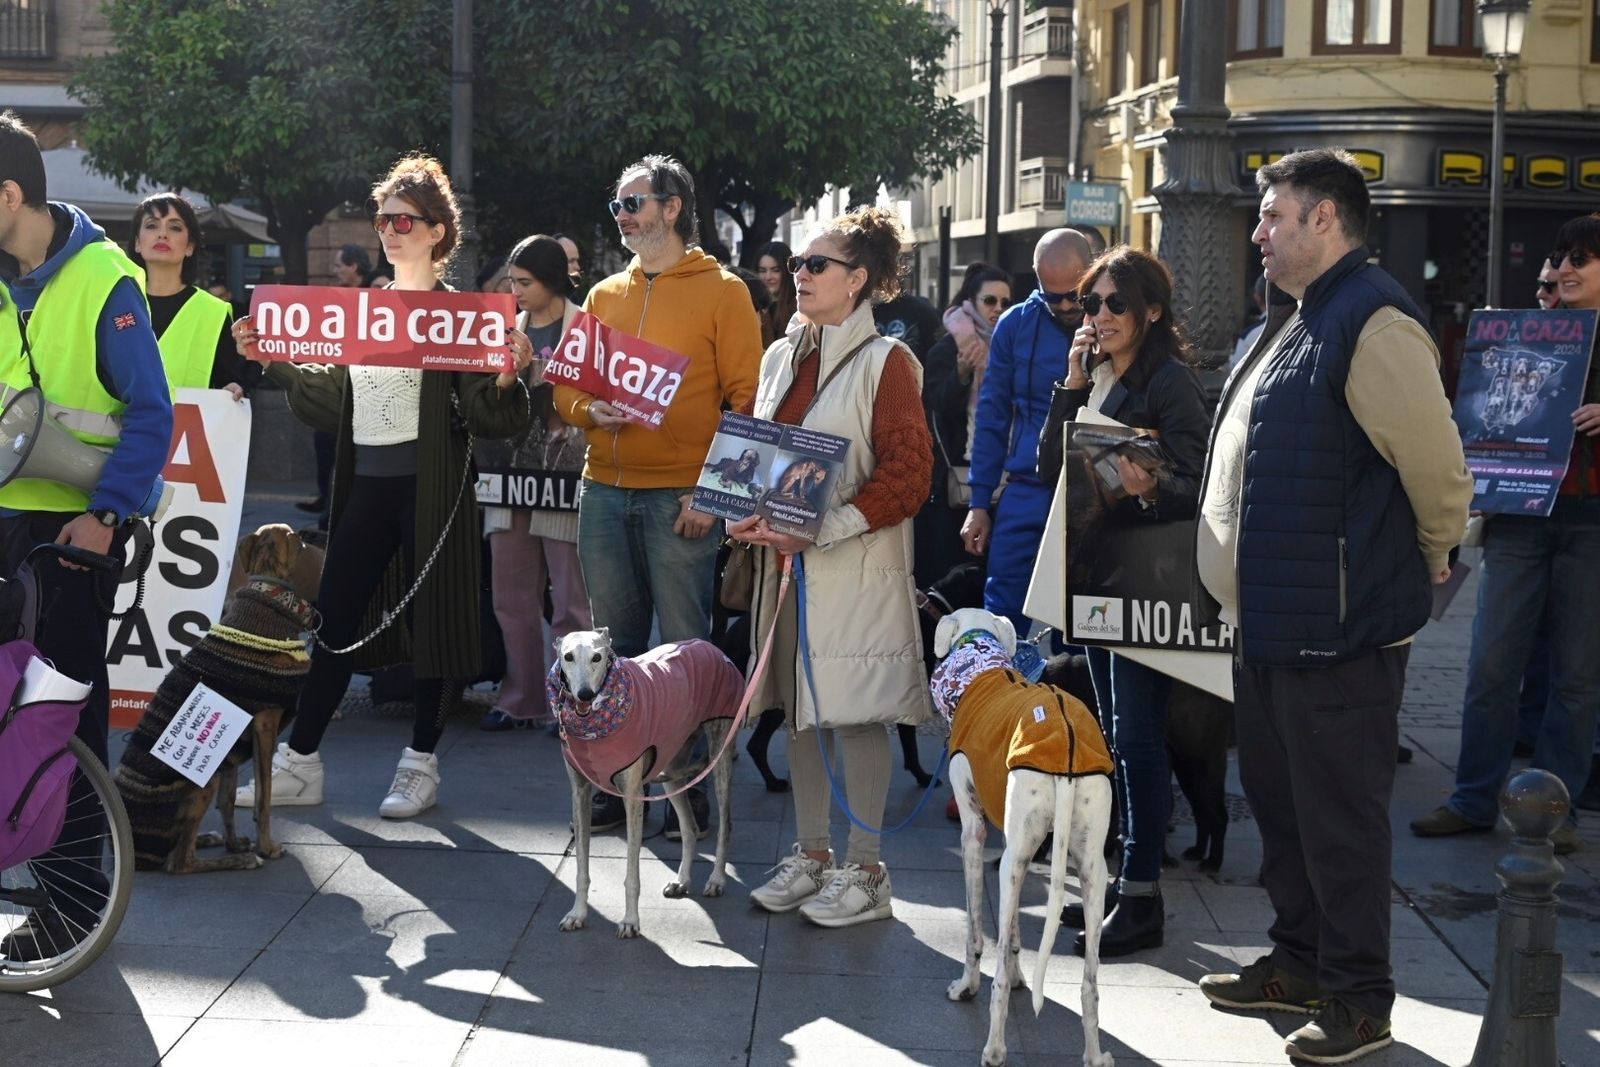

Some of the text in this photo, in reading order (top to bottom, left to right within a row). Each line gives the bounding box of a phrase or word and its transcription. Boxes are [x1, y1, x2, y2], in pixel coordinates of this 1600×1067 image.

[1083, 186, 1104, 198] BAR
[1071, 199, 1115, 220] CORREO
[257, 292, 506, 347] no a la caza
[1475, 319, 1509, 341] NO
[1522, 319, 1584, 341] CAZA
[257, 338, 343, 359] con perros
[1553, 344, 1582, 355] 2024
[422, 354, 484, 368] plataformanac.org
[564, 328, 587, 364] a
[608, 351, 682, 407] caza
[508, 475, 538, 507] NO
[541, 478, 556, 508] A
[702, 491, 713, 500] NO
[1132, 600, 1171, 645] NO
[1176, 602, 1196, 646] A
[172, 704, 211, 761] CON 6 MESES
[196, 729, 210, 744] NO
[158, 737, 174, 754] ME
[196, 723, 230, 773] PARA CAZAR
